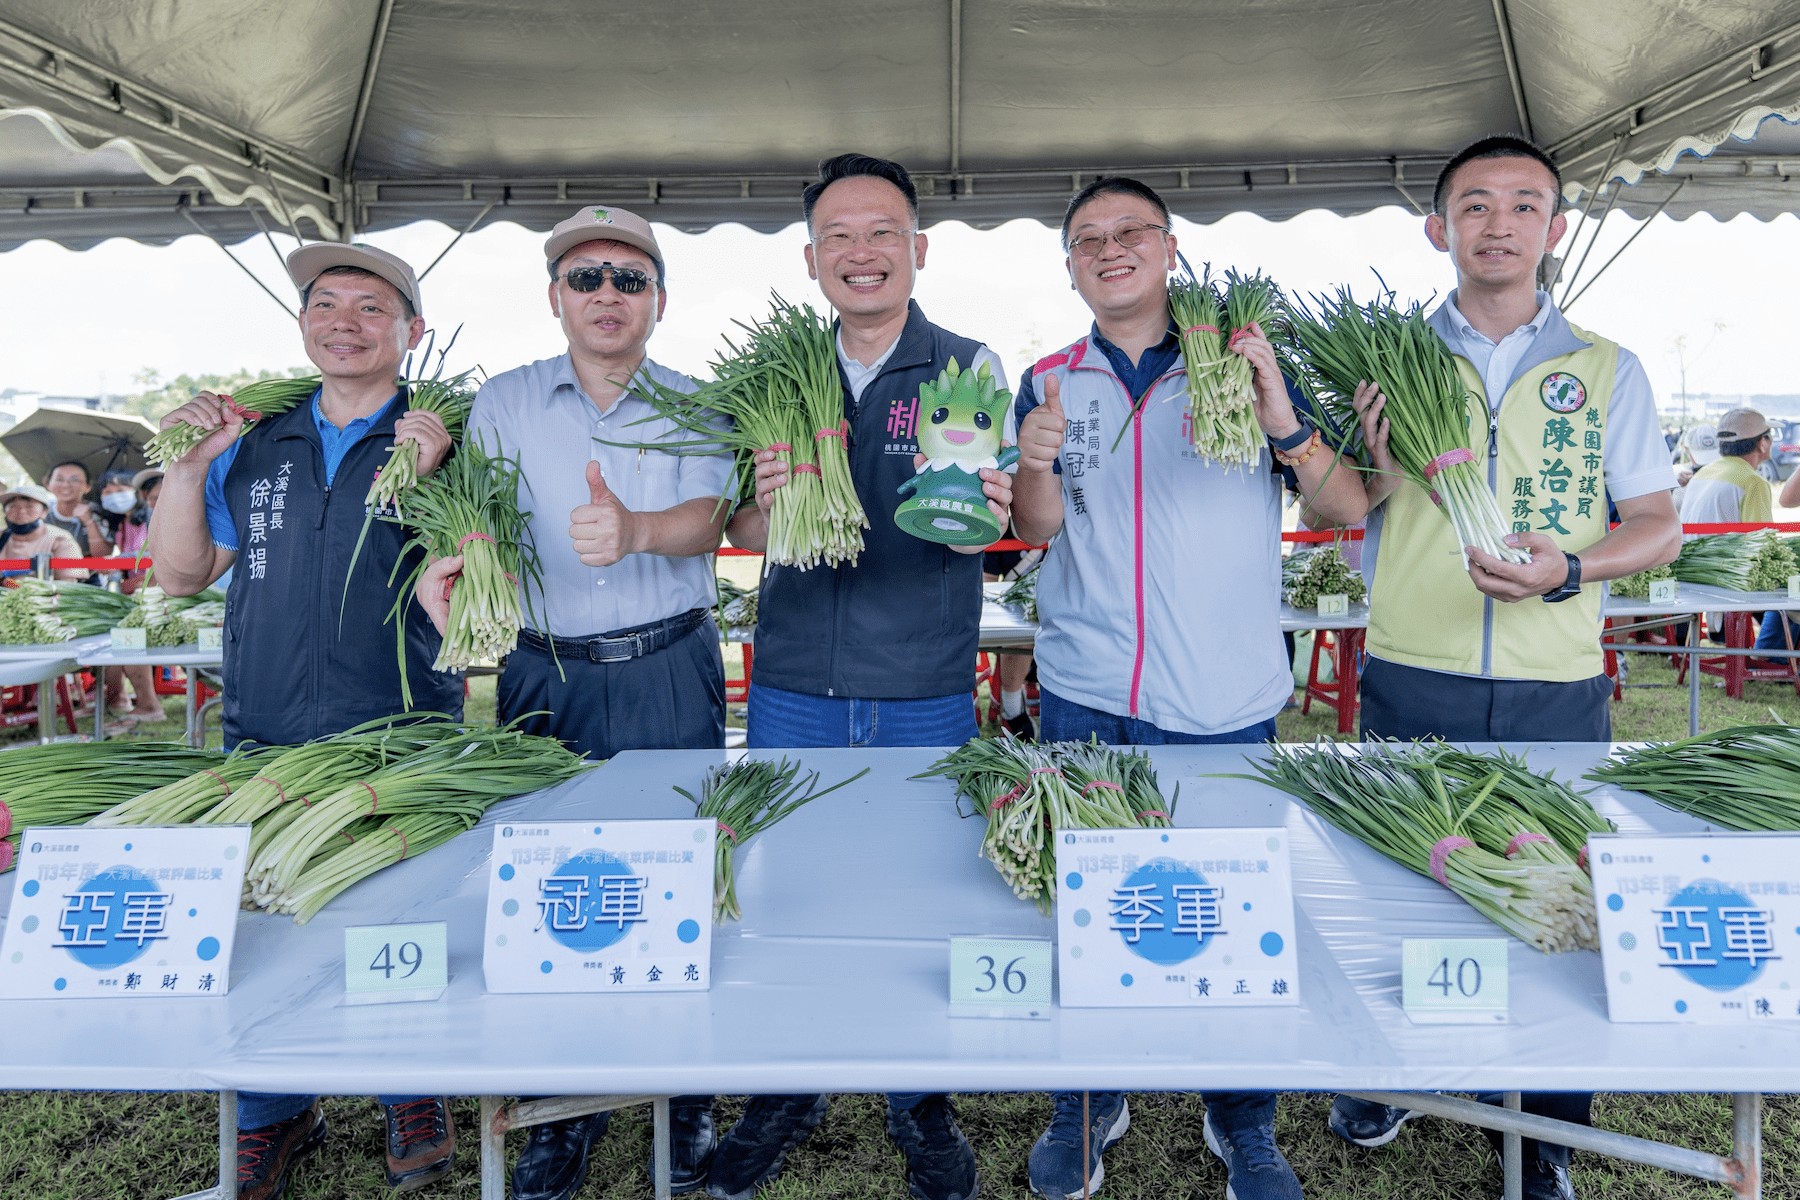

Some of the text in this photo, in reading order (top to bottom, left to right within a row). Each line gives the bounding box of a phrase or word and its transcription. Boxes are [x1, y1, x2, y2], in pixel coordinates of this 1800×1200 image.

[884, 443, 922, 453] 桃園市政
[1087, 399, 1100, 470] 農業局長
[1065, 418, 1087, 516] 陳冠義
[1536, 416, 1579, 536] 陳治文
[1574, 406, 1603, 520] 桃園市議員
[269, 460, 294, 530] 大溪區長
[918, 498, 974, 513] 大溪區農會
[248, 478, 272, 580] 徐景揚
[1327, 600, 1341, 613] 12
[1655, 586, 1669, 599] 42
[124, 634, 133, 647] 8
[37, 861, 224, 881] 113年度 大溪區韭菜評鑑比賽
[511, 845, 694, 865] 113年度 大溪區韭菜評鑑比賽
[1076, 853, 1270, 874] 113年度 大溪區韭菜評鑑比賽
[534, 875, 649, 933] 冠軍
[1614, 875, 1682, 895] 113年度
[51, 891, 174, 948] 亞軍
[1108, 883, 1228, 944] 季軍
[1651, 906, 1784, 970] 亞軍
[369, 941, 423, 979] 49
[609, 963, 700, 985] 黃金亮
[975, 955, 1027, 995] 36
[1427, 957, 1482, 997] 40
[123, 972, 216, 991] 鄭財清
[1194, 977, 1290, 997] 黃正雄
